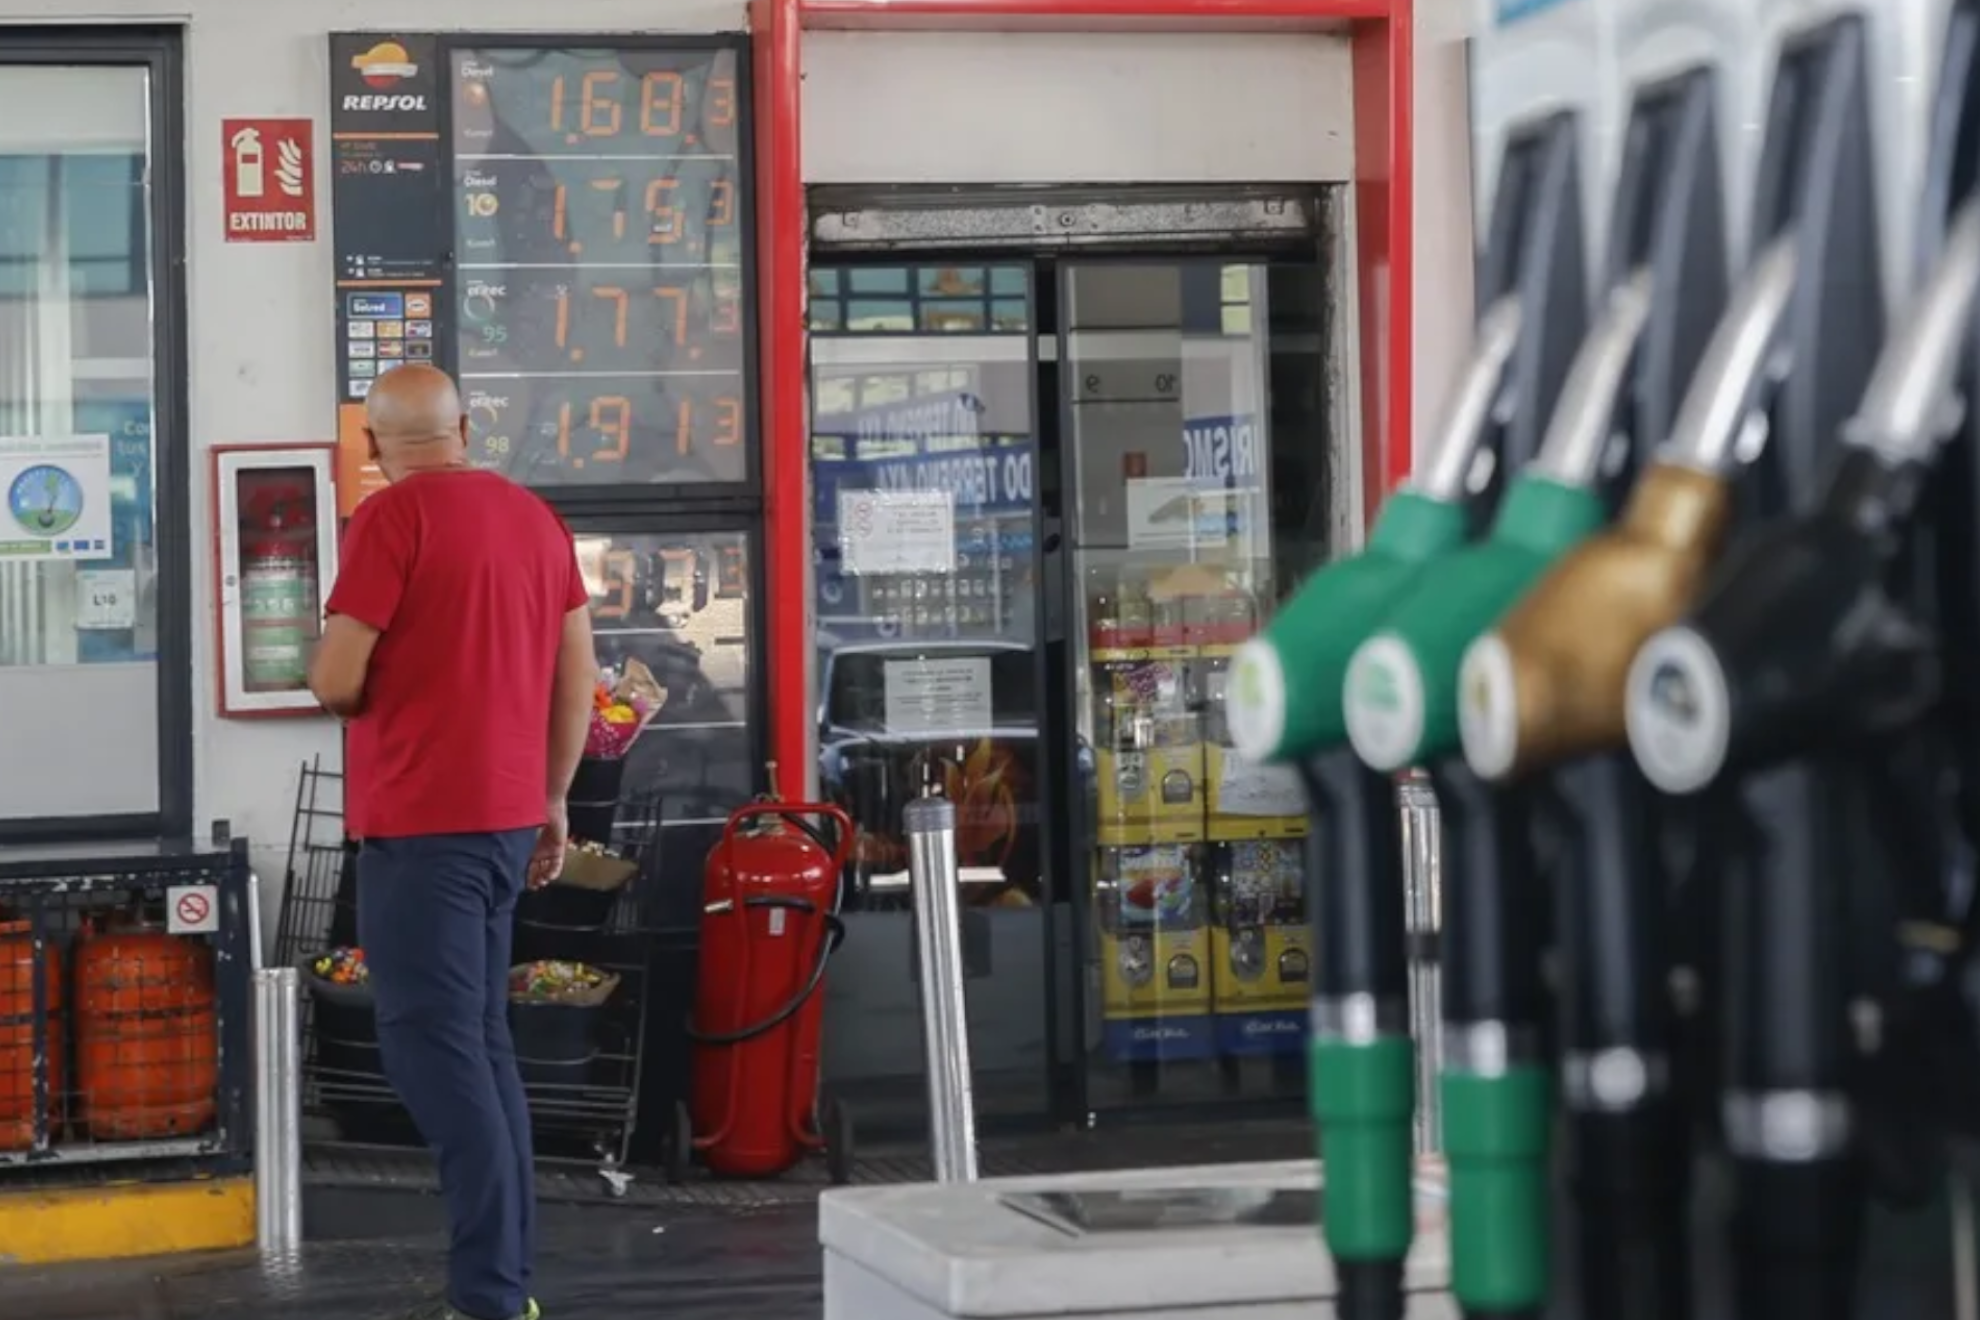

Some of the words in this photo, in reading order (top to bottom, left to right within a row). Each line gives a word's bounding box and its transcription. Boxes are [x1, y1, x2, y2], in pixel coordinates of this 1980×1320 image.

[343, 95, 428, 111] REPSOL
[466, 193, 499, 216] 10
[230, 211, 307, 231] EXTINTOR
[483, 325, 508, 342] 95
[485, 436, 509, 453] 98
